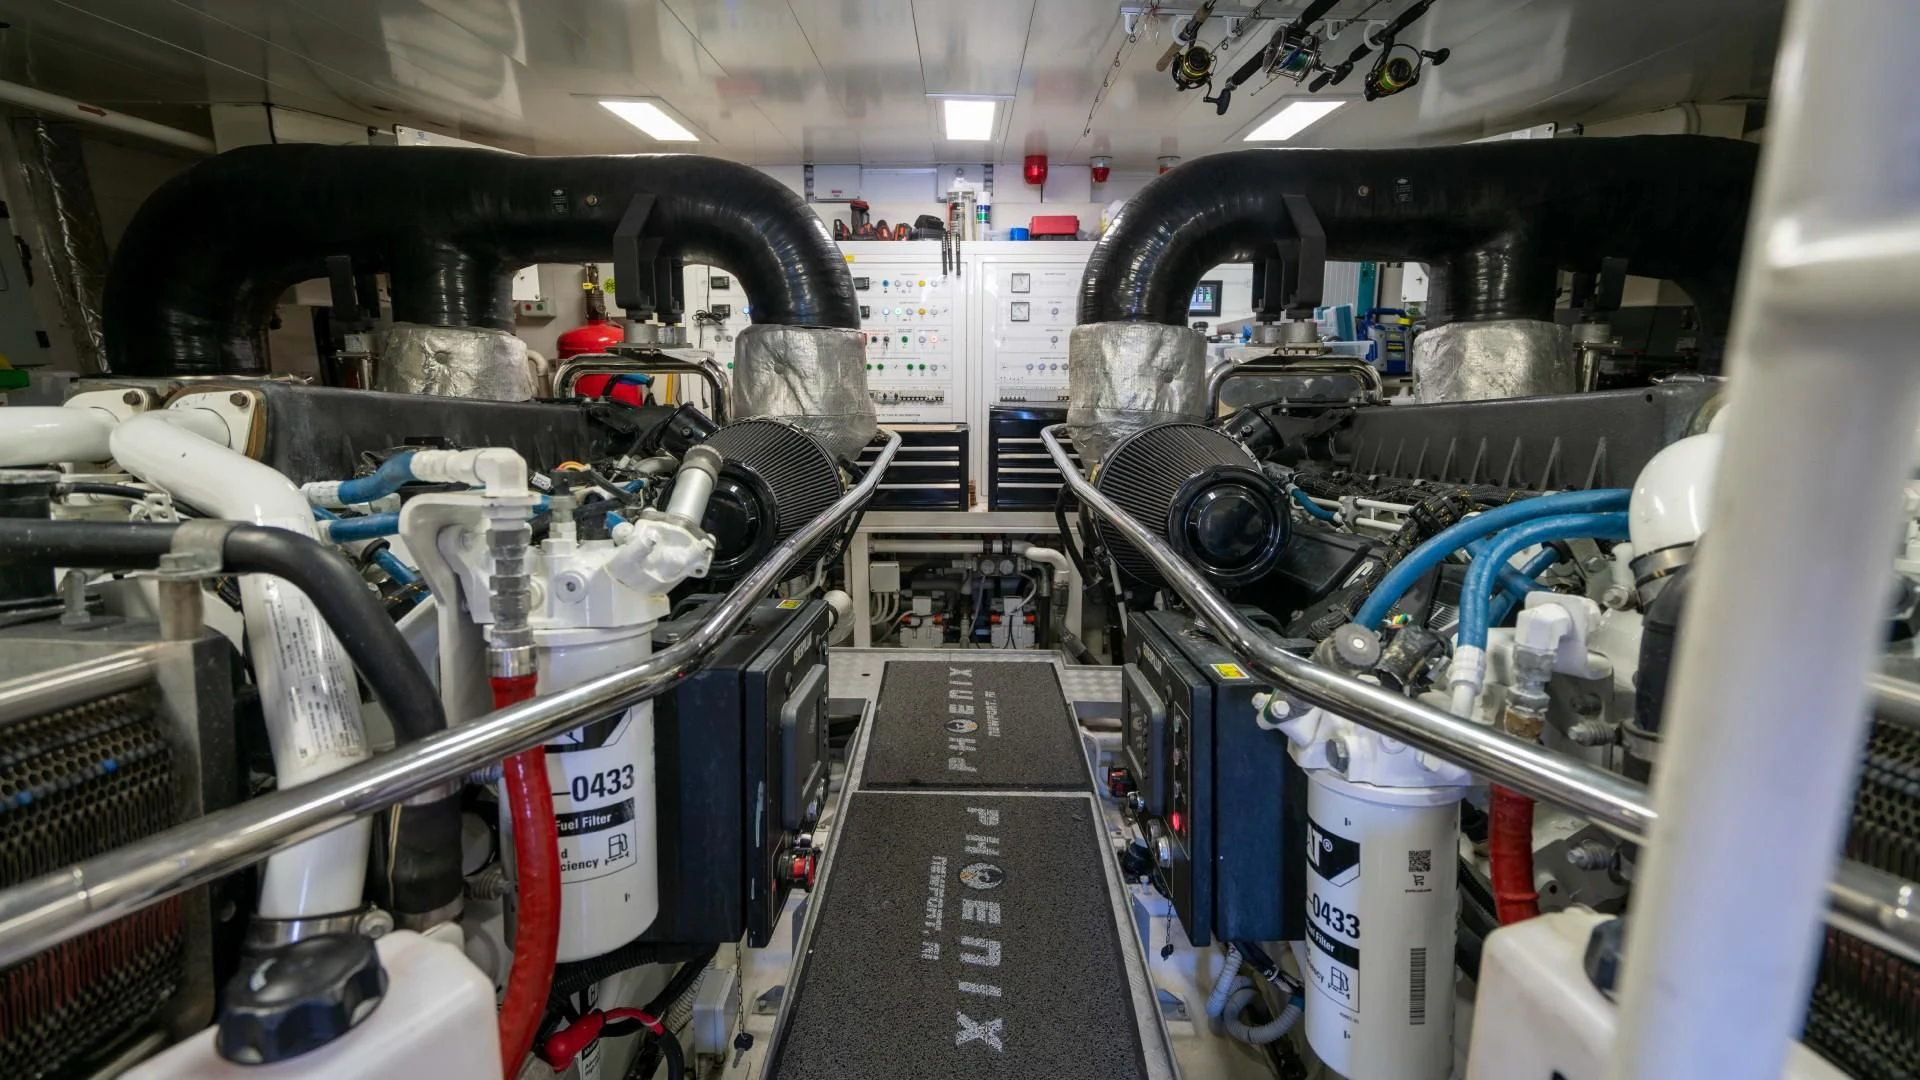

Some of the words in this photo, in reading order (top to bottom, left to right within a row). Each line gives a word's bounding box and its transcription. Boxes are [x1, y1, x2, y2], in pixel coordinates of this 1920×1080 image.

[945, 667, 978, 772] PHOENIX
[582, 814, 612, 829] Filter
[955, 806, 1004, 1052] PHOENIX
[1315, 932, 1336, 953] Filter
